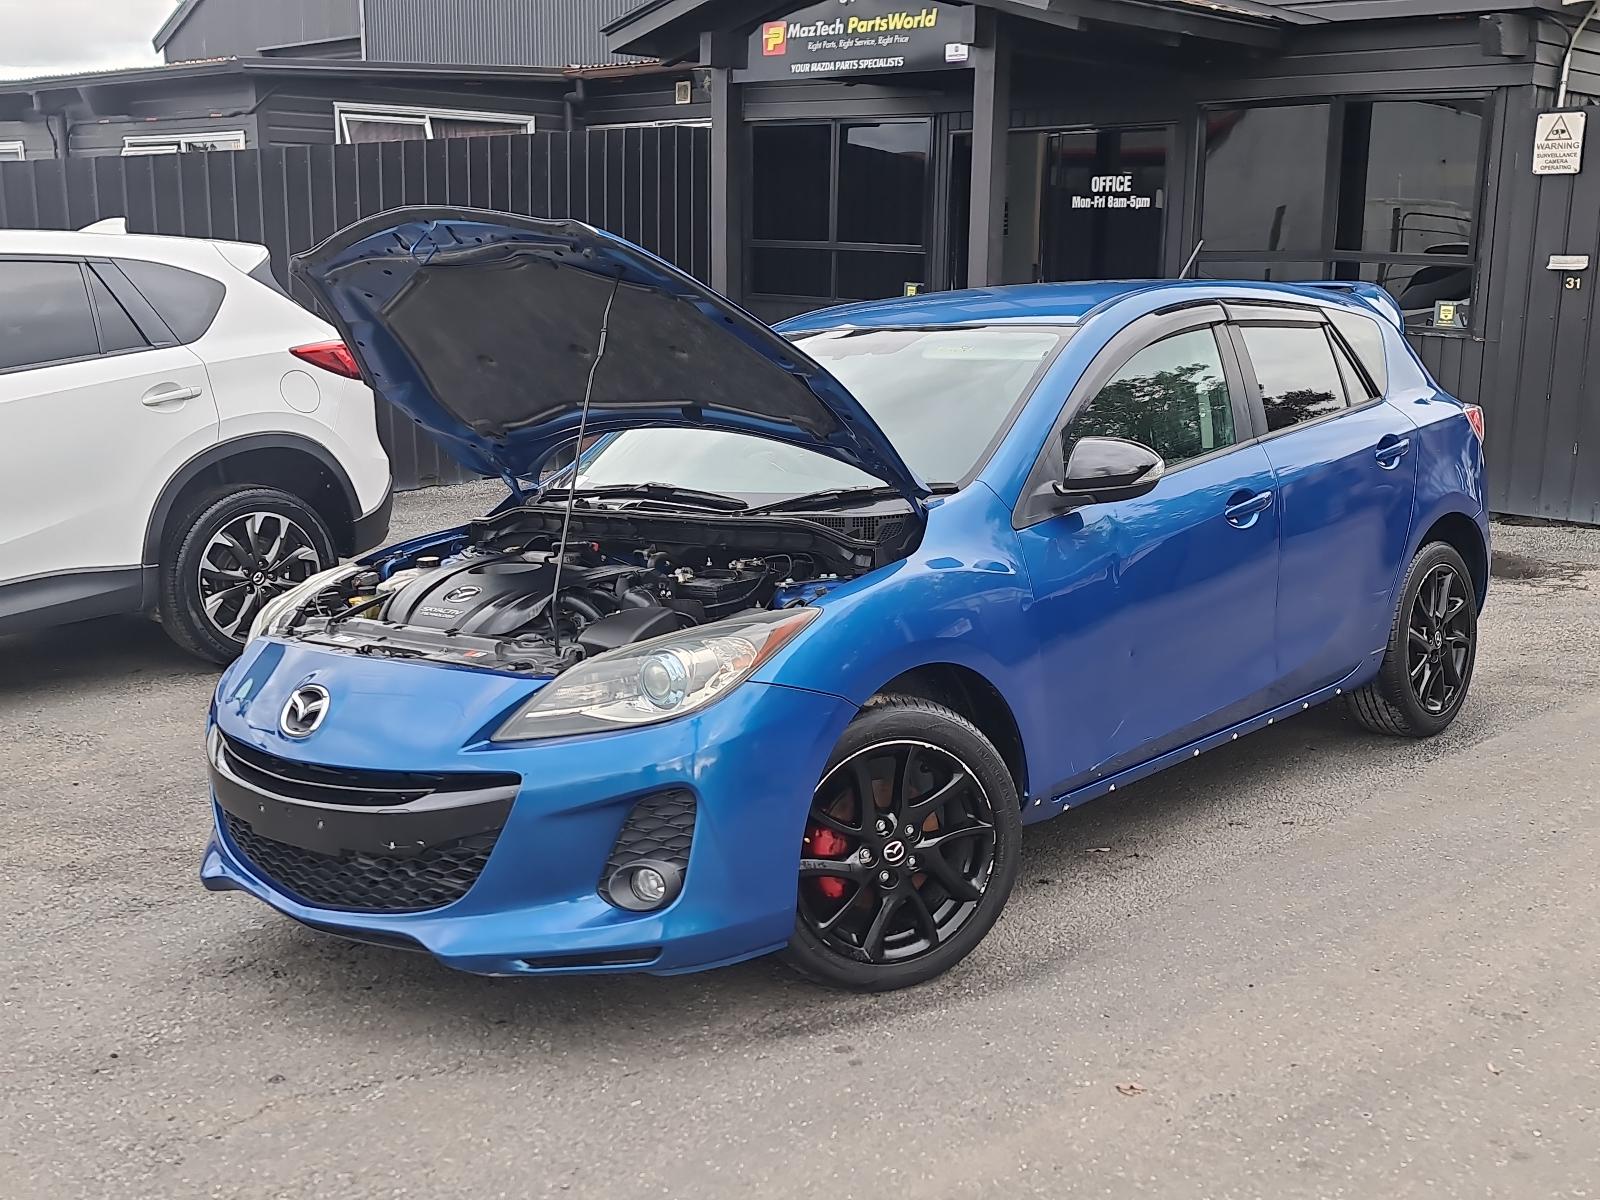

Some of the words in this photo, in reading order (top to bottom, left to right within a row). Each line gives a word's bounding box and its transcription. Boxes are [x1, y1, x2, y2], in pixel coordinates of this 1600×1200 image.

[787, 18, 845, 39] MazTech
[848, 8, 937, 34] PartsWorld
[808, 41, 822, 52] Right
[838, 39, 854, 50] Right
[877, 36, 893, 47] Right
[893, 34, 910, 44] Price
[791, 63, 810, 73] YOUR
[810, 61, 834, 72] MAZDA
[835, 60, 858, 70] PARTS
[859, 56, 905, 69] SPECIALISTS
[1536, 141, 1580, 150] WARNING
[1091, 175, 1132, 193] OFFICE
[1071, 195, 1106, 209] Mon-Fri
[1107, 195, 1151, 210] 8am-5pm
[1565, 277, 1581, 289] 31
